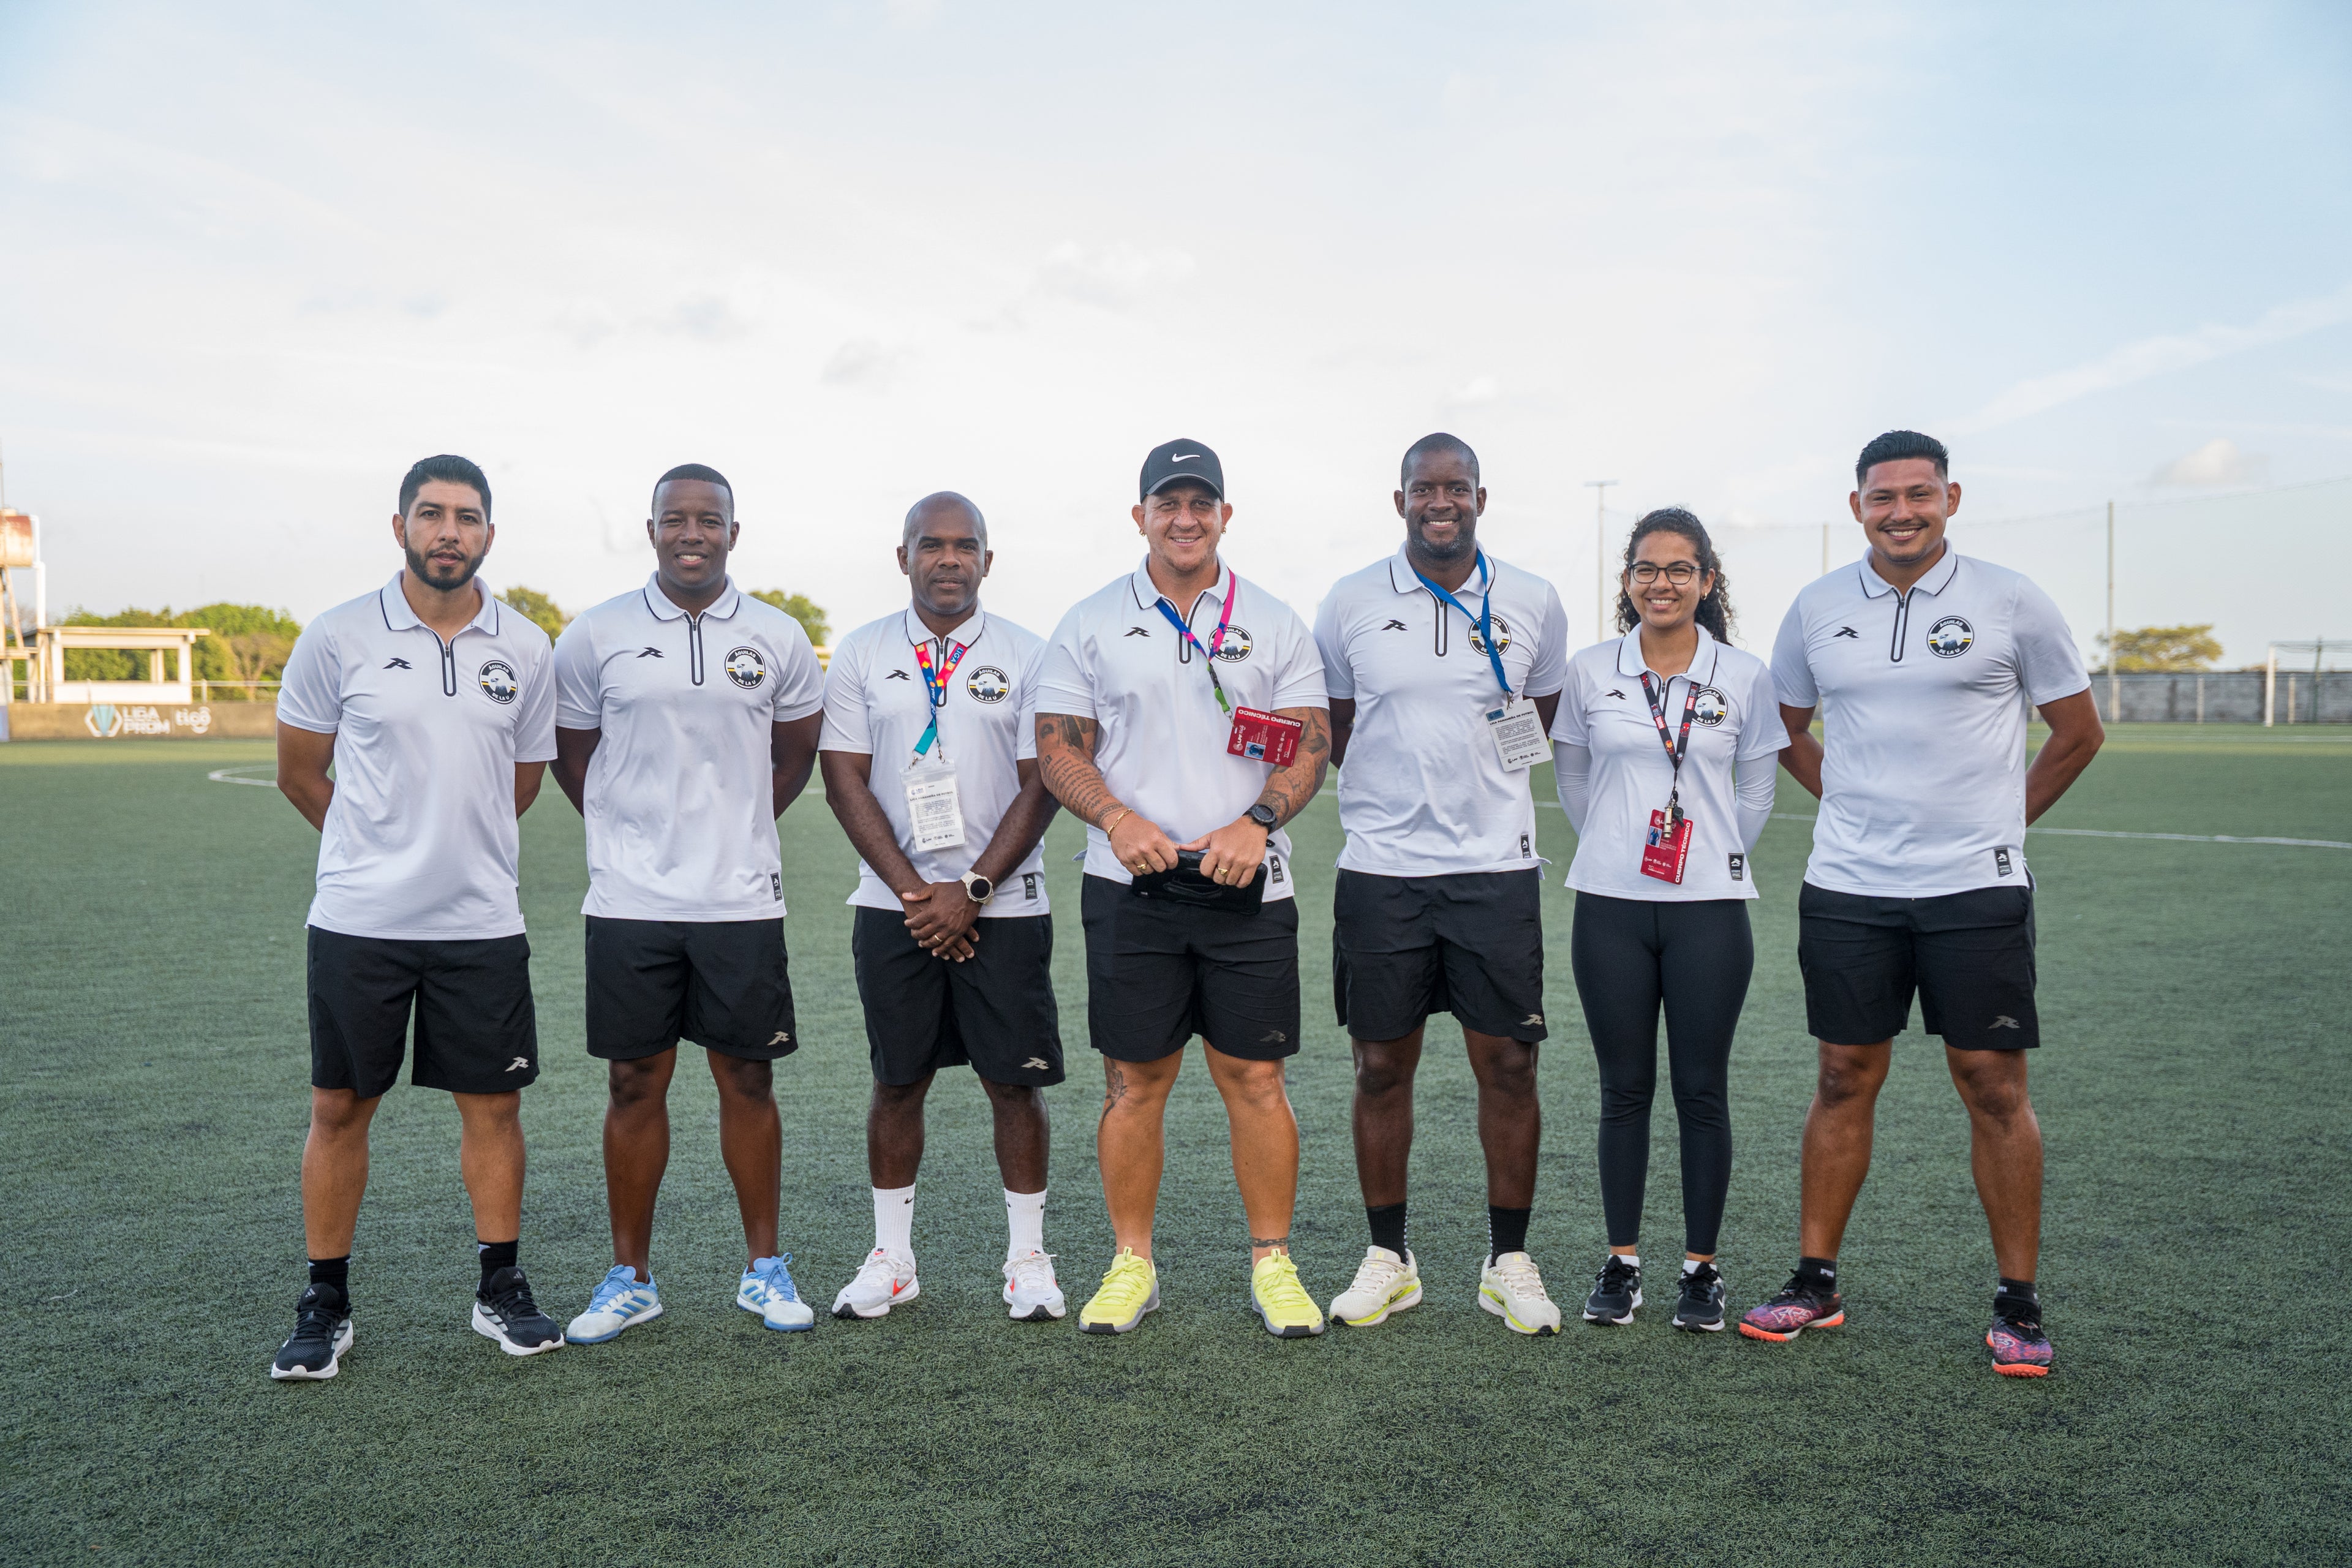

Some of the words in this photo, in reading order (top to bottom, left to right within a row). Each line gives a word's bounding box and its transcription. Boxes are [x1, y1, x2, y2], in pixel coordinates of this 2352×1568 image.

[951, 647, 963, 663] LIGA
[123, 706, 160, 719] LIGA
[1238, 709, 1270, 721] TÉCNICO
[123, 719, 171, 734] PROM
[1270, 717, 1301, 727] CUERPO
[1675, 853, 1684, 883] CUERPO
[1681, 822, 1691, 853] TÉCNICO
